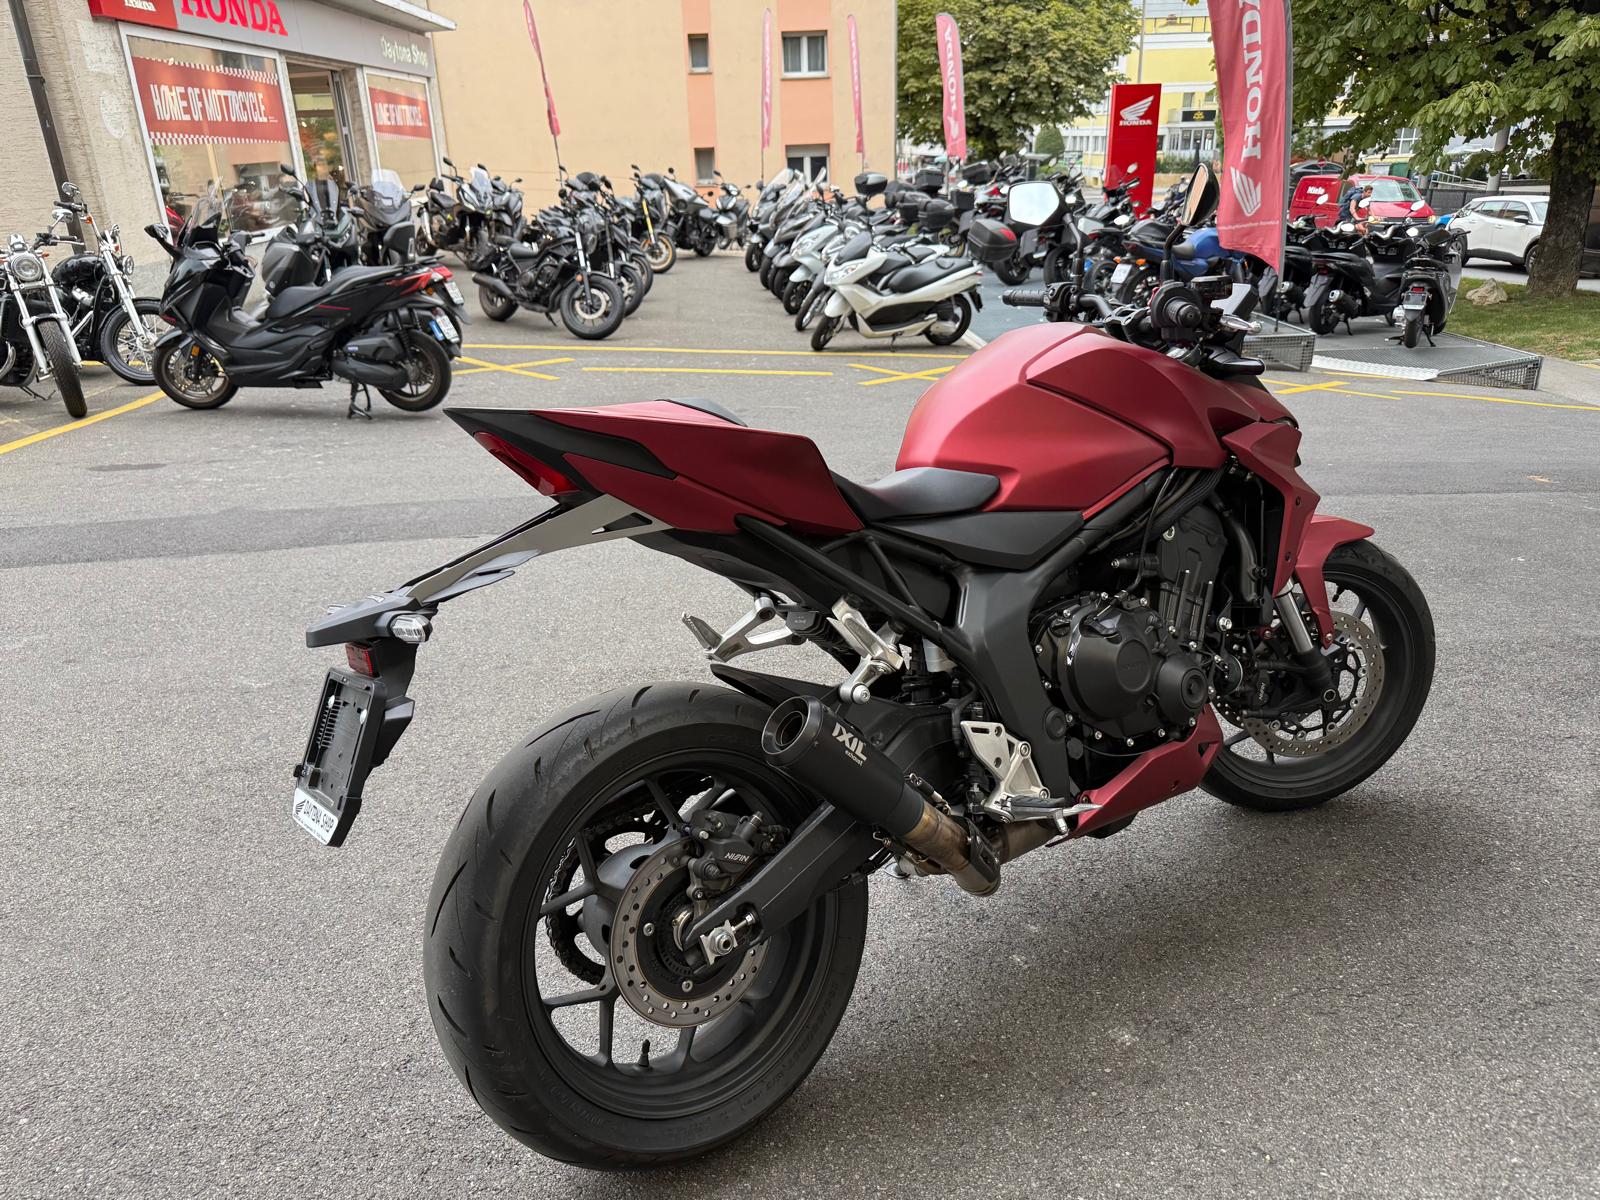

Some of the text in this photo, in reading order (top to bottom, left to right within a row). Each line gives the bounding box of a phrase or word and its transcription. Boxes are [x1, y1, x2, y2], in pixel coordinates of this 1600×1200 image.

[181, 0, 289, 36] HONDA
[1238, 0, 1263, 163] HOND
[150, 84, 191, 121] HOME
[187, 86, 203, 122] OF
[831, 721, 868, 762] IXIL
